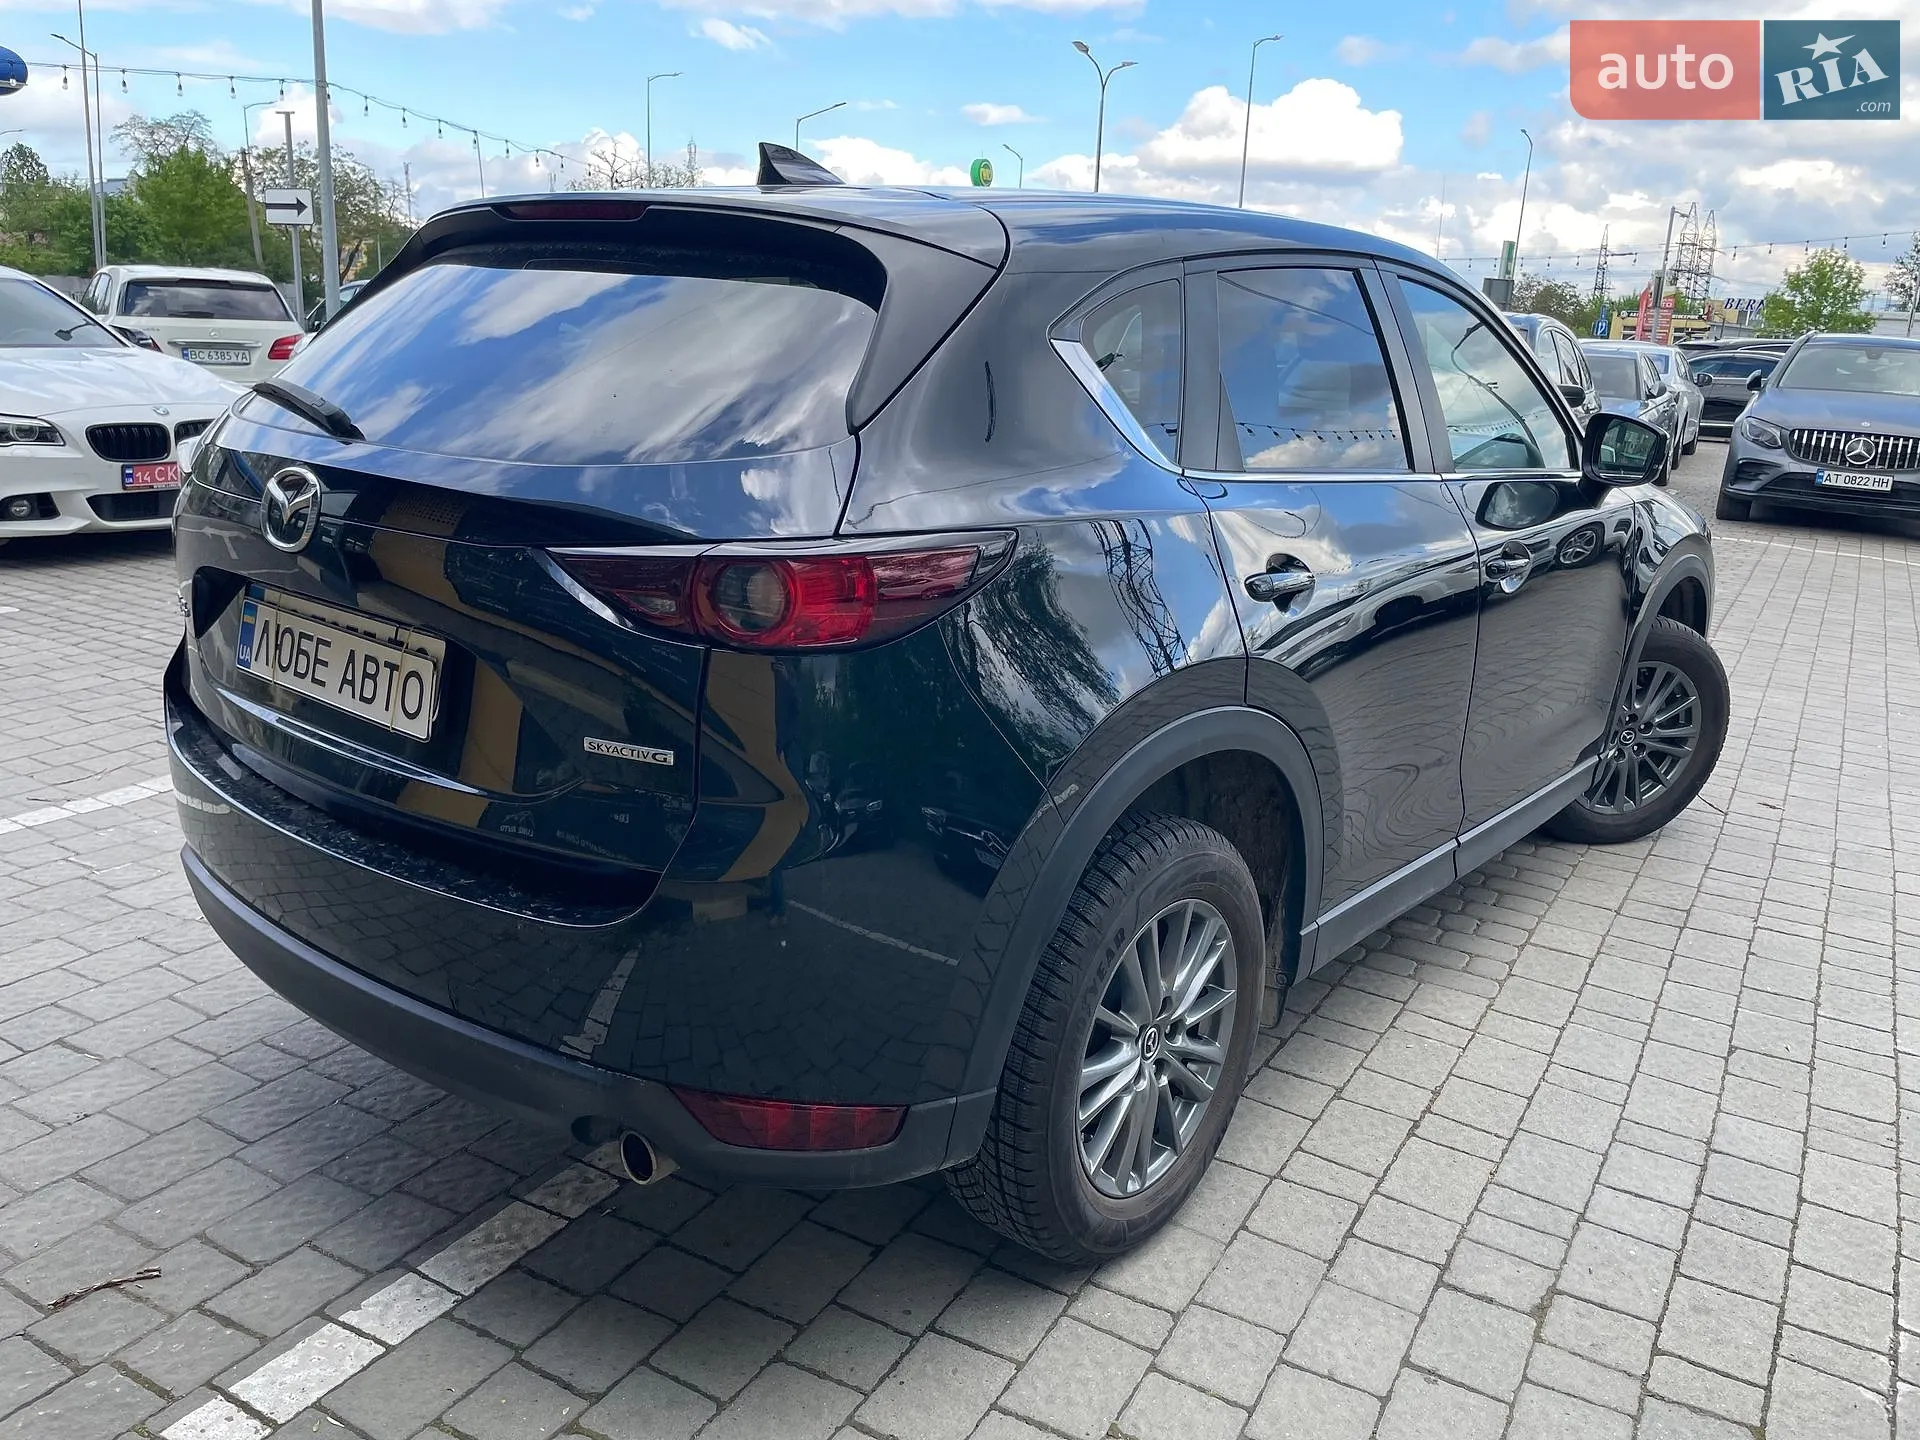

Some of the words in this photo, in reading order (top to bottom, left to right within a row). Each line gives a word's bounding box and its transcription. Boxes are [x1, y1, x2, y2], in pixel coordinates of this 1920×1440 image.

[190, 350, 205, 360] BC
[207, 351, 232, 360] 6385
[136, 471, 151, 483] 14
[155, 465, 177, 481] CK
[1824, 473, 1842, 484] AT
[1843, 475, 1870, 487] 0822
[1872, 477, 1890, 488] HH
[239, 643, 251, 663] UA
[254, 619, 332, 688] ЛЮБЕ
[338, 648, 424, 720] АВТО
